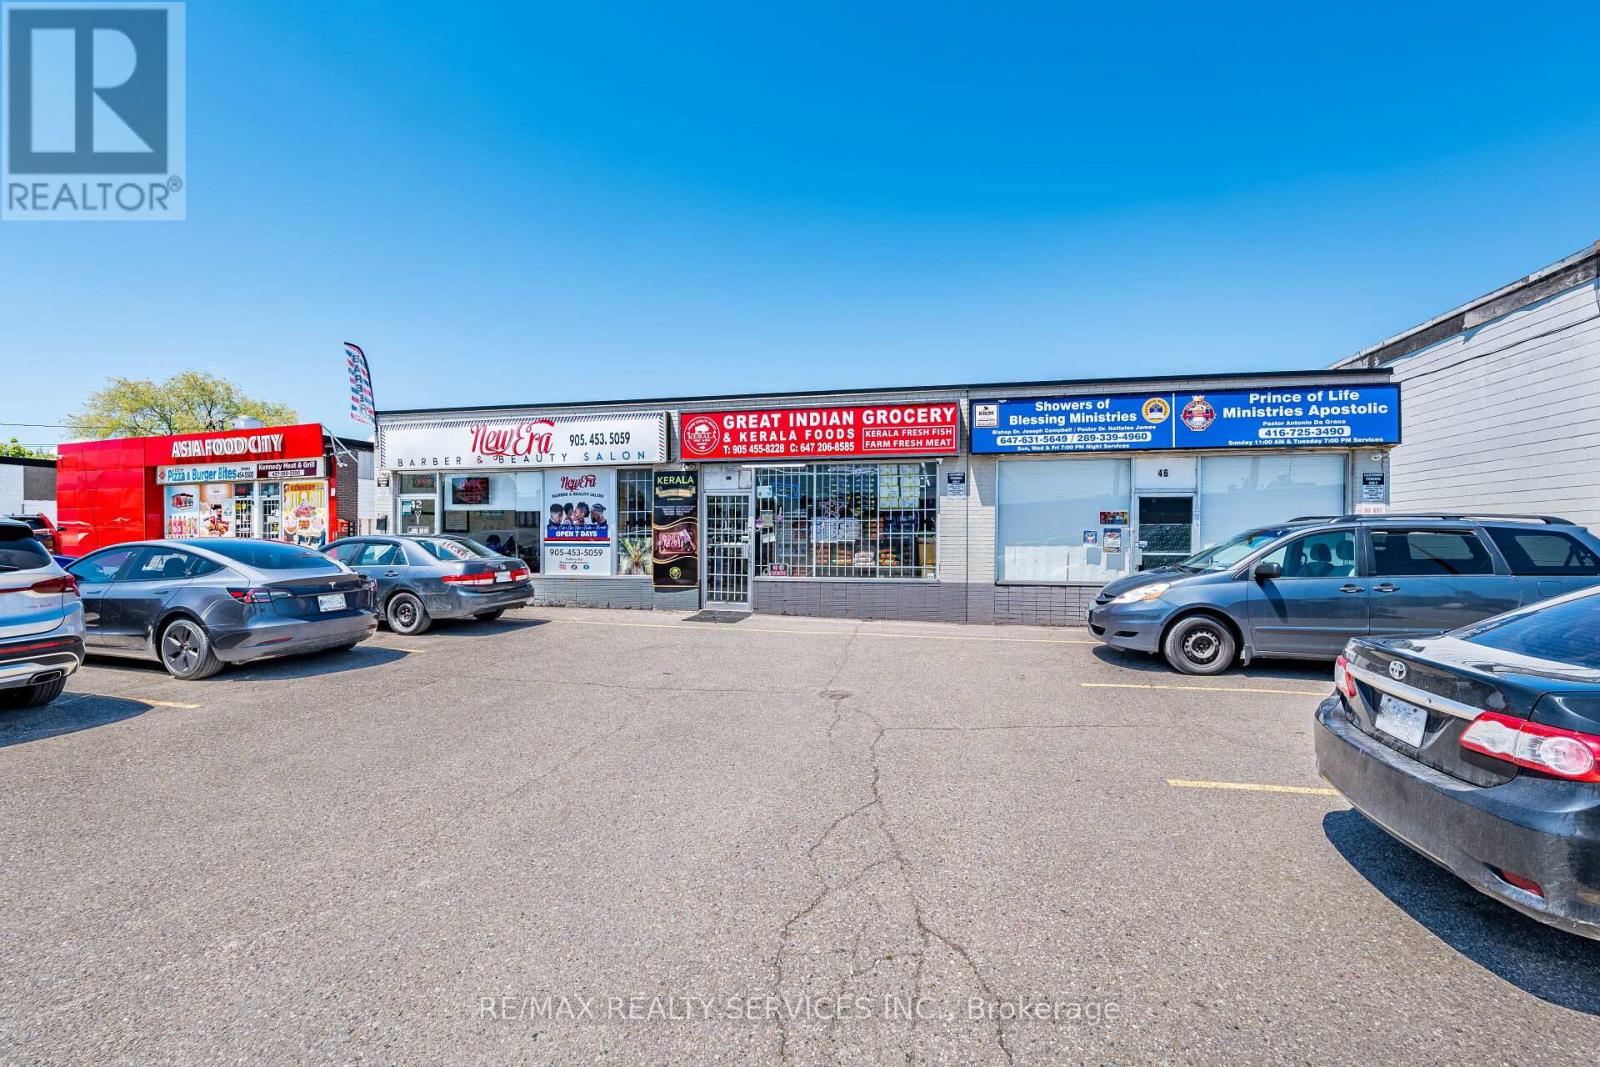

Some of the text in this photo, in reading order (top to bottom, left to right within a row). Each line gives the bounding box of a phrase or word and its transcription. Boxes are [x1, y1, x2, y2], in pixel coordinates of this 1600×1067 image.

[1249, 389, 1360, 404] Prince of Life
[1035, 398, 1110, 412] Showers of
[1222, 405, 1304, 418] Ministries
[1308, 402, 1389, 419] Apostolic
[723, 413, 782, 430] GREAT
[789, 410, 854, 428] INDIAN
[862, 407, 956, 425] GROCERY
[1009, 414, 1066, 426] Blessing
[1069, 411, 1137, 423] Ministries
[470, 418, 556, 457] New Era
[723, 428, 855, 443] & KERALA FOODS
[865, 428, 953, 438] KERALA FRESH FISH
[1000, 435, 1068, 445] 647-631-5649
[1077, 432, 1148, 442] 289-339-4960
[1265, 427, 1345, 437] 416-725-3490
[172, 434, 283, 458] ASIA FOOD CITY
[723, 441, 855, 454] T: 905 455-8228 C: 647 206-8585
[865, 438, 952, 448] FARM FRESH MEAT
[397, 450, 645, 467] BARBER & BEAUTY SALON
[167, 469, 186, 482] Pizza
[193, 467, 218, 482] Burger
[221, 465, 237, 479] Bites
[657, 475, 694, 485] KERALA
[1158, 469, 1169, 478] 46
[549, 549, 604, 557] 905-453-5059
